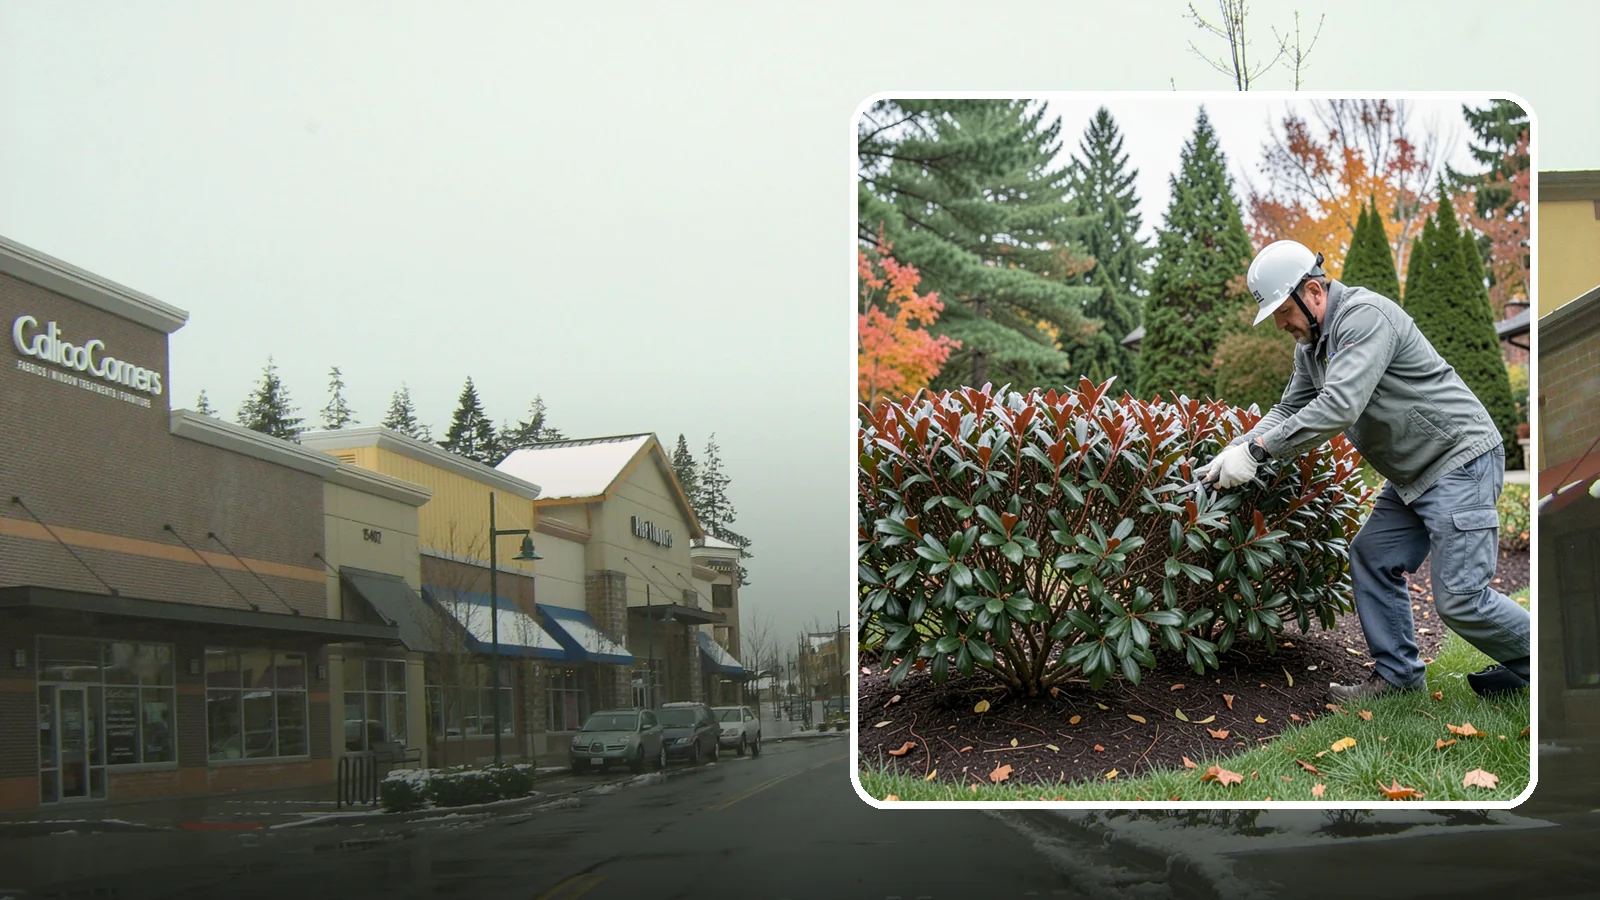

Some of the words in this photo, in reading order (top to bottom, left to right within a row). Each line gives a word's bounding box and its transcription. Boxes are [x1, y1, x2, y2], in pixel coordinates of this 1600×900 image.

[16, 360, 47, 377] FABRICS
[51, 371, 78, 387] WINDOW
[78, 379, 117, 399] TREATMENTS
